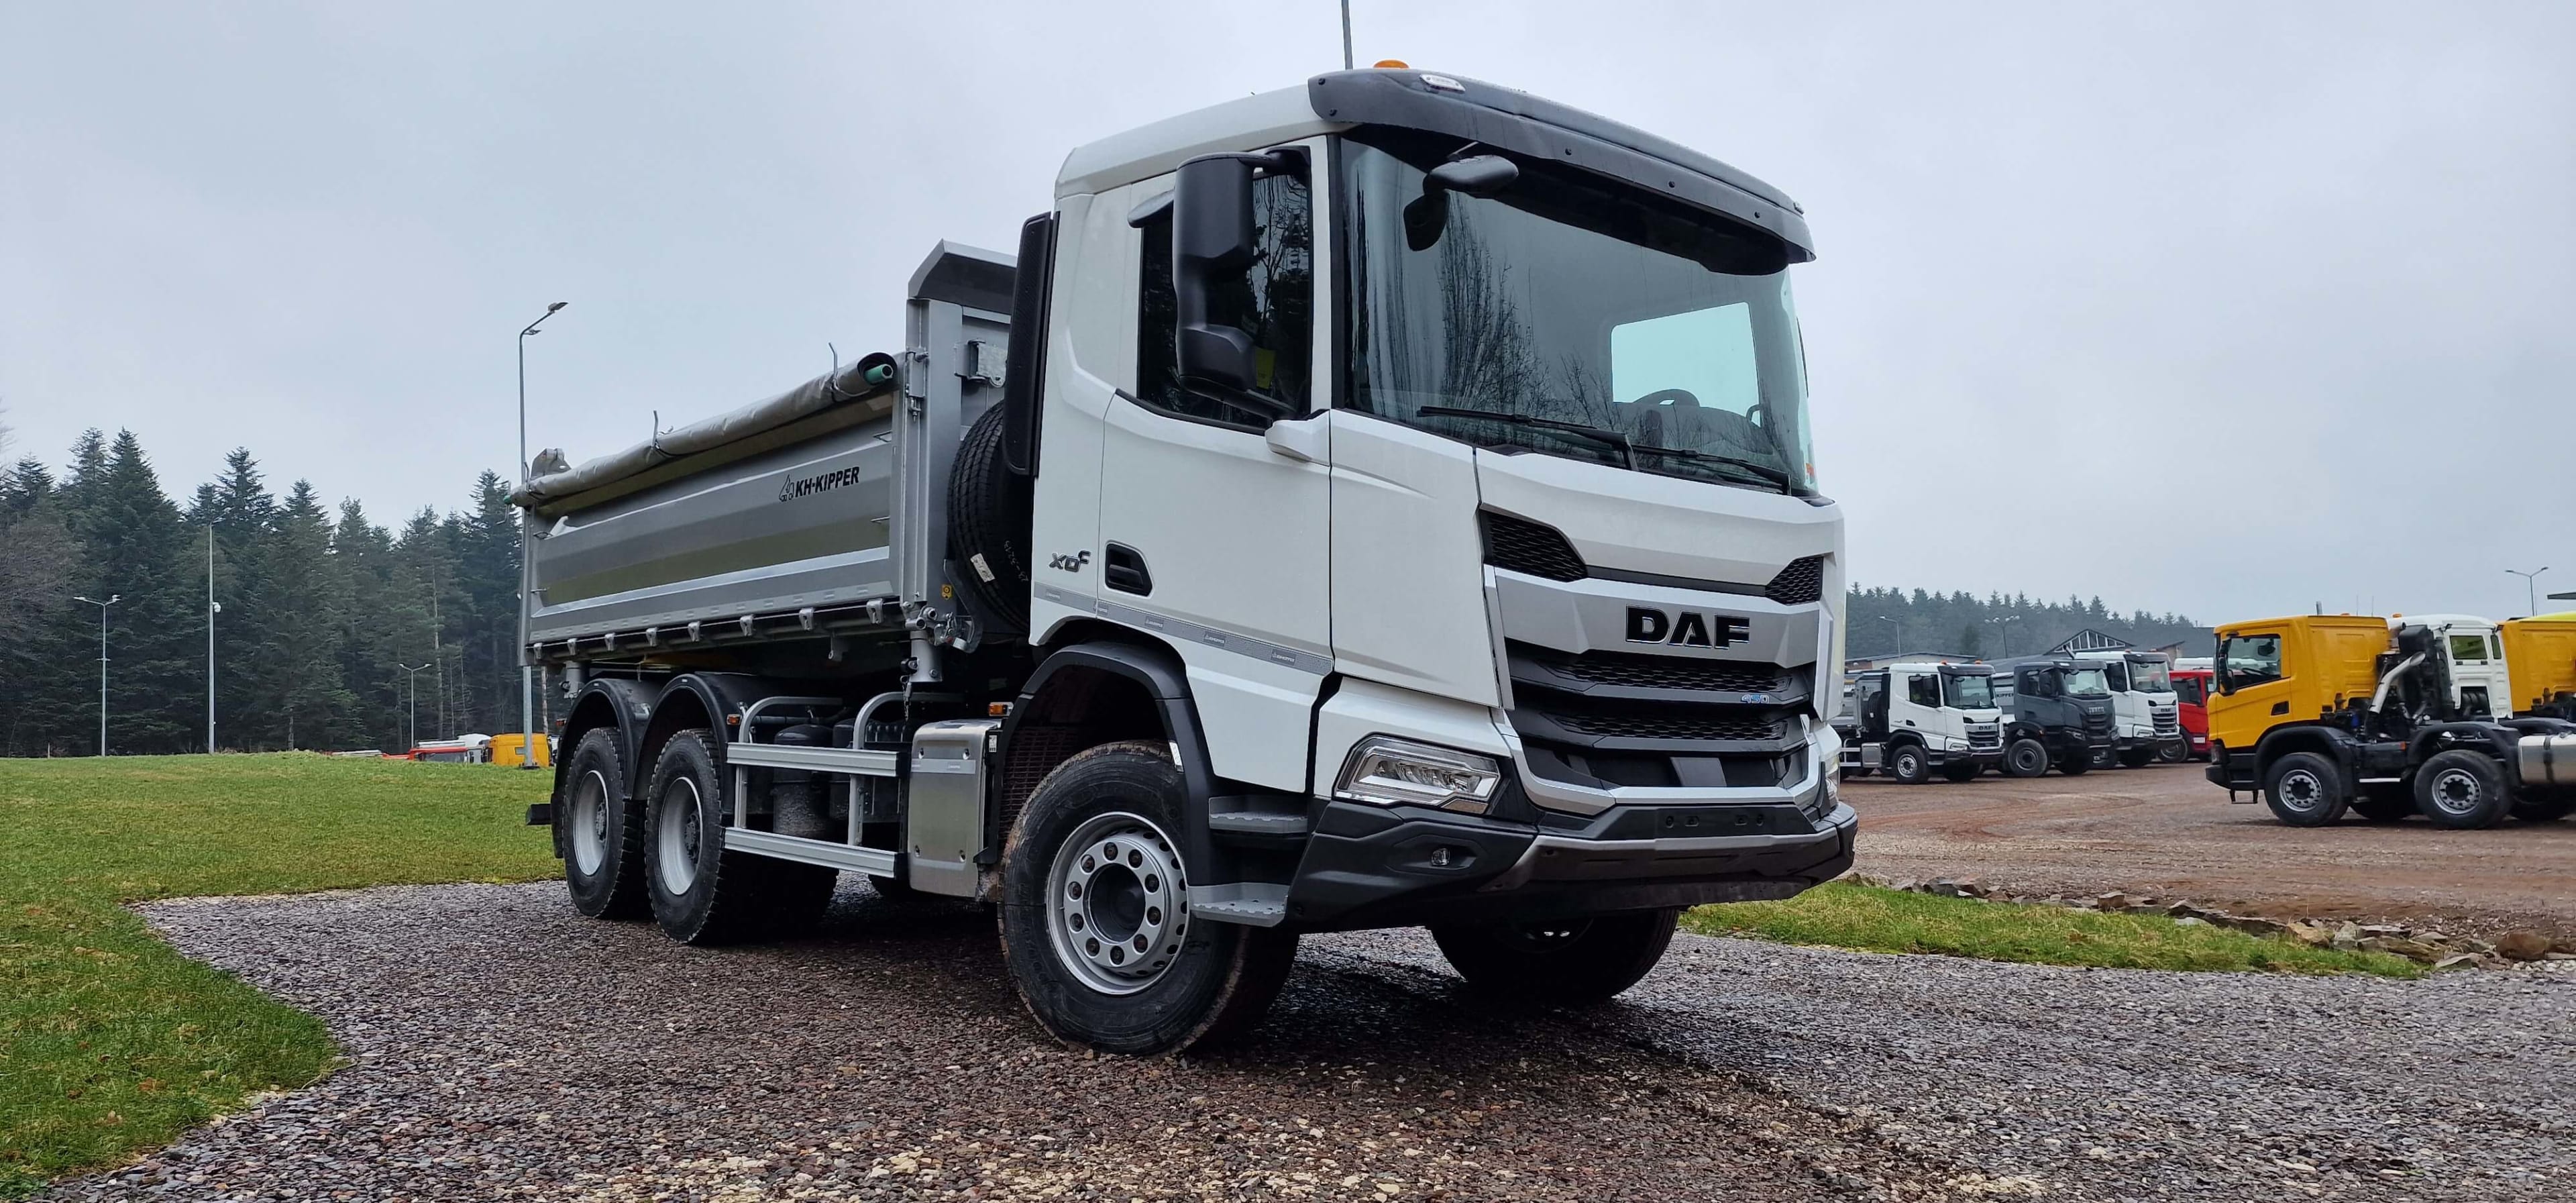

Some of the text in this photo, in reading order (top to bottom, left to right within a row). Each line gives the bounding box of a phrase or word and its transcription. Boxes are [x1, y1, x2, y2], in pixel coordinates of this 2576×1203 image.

[795, 466, 860, 498] KH-KIPPER
[1625, 604, 1750, 650] DAF
[1741, 694, 1770, 704] 450
